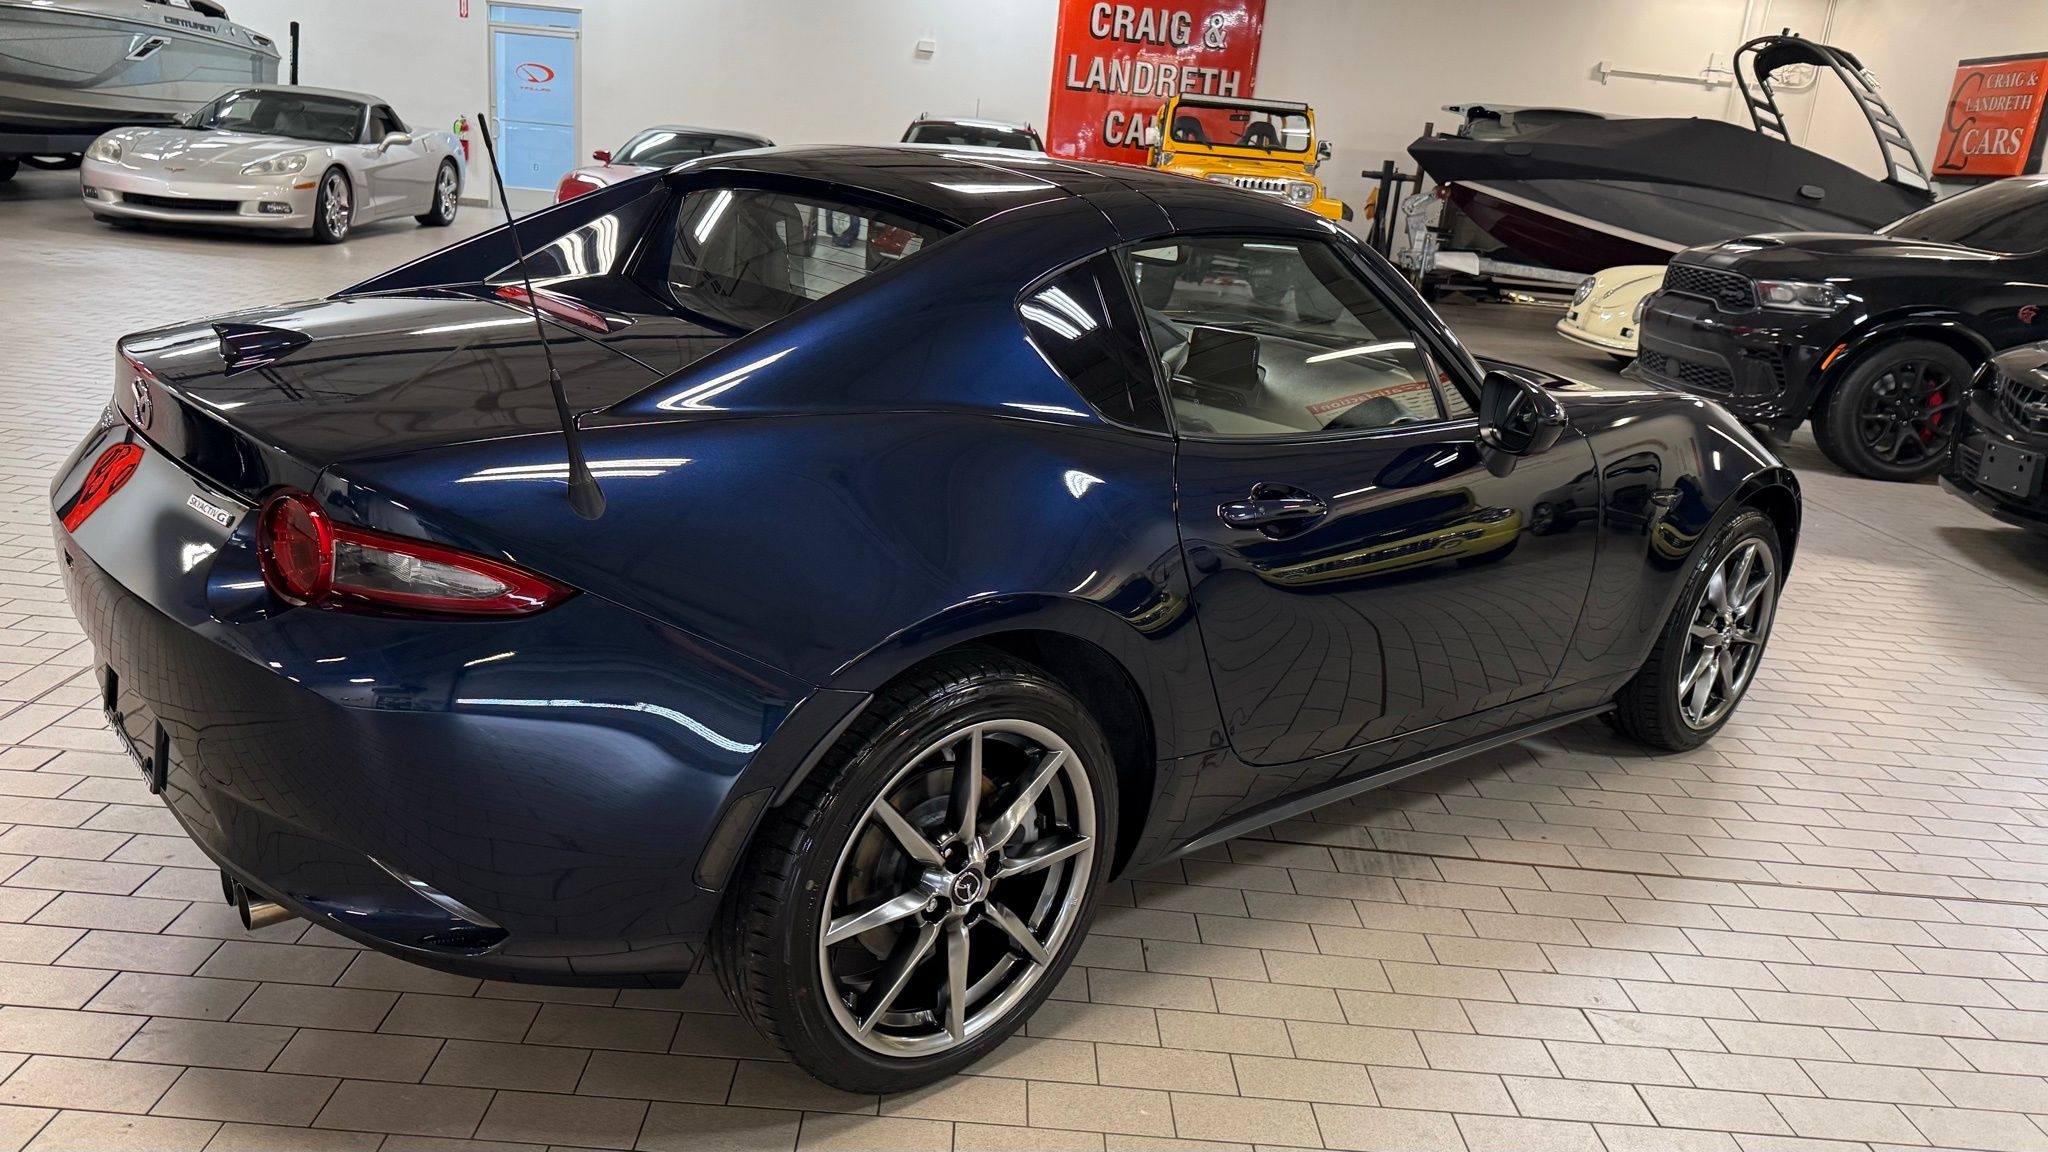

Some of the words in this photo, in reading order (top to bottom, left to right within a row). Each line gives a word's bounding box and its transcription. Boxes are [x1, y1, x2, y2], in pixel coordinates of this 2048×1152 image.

[1091, 2, 1192, 46] CRAIG
[1204, 14, 1227, 48] &
[1067, 54, 1241, 97] LANDRETH
[1986, 72, 2025, 88] CRAIG
[2027, 71, 2038, 86] &
[1965, 95, 2033, 112] LANDRETH
[1962, 127, 2023, 155] CARS
